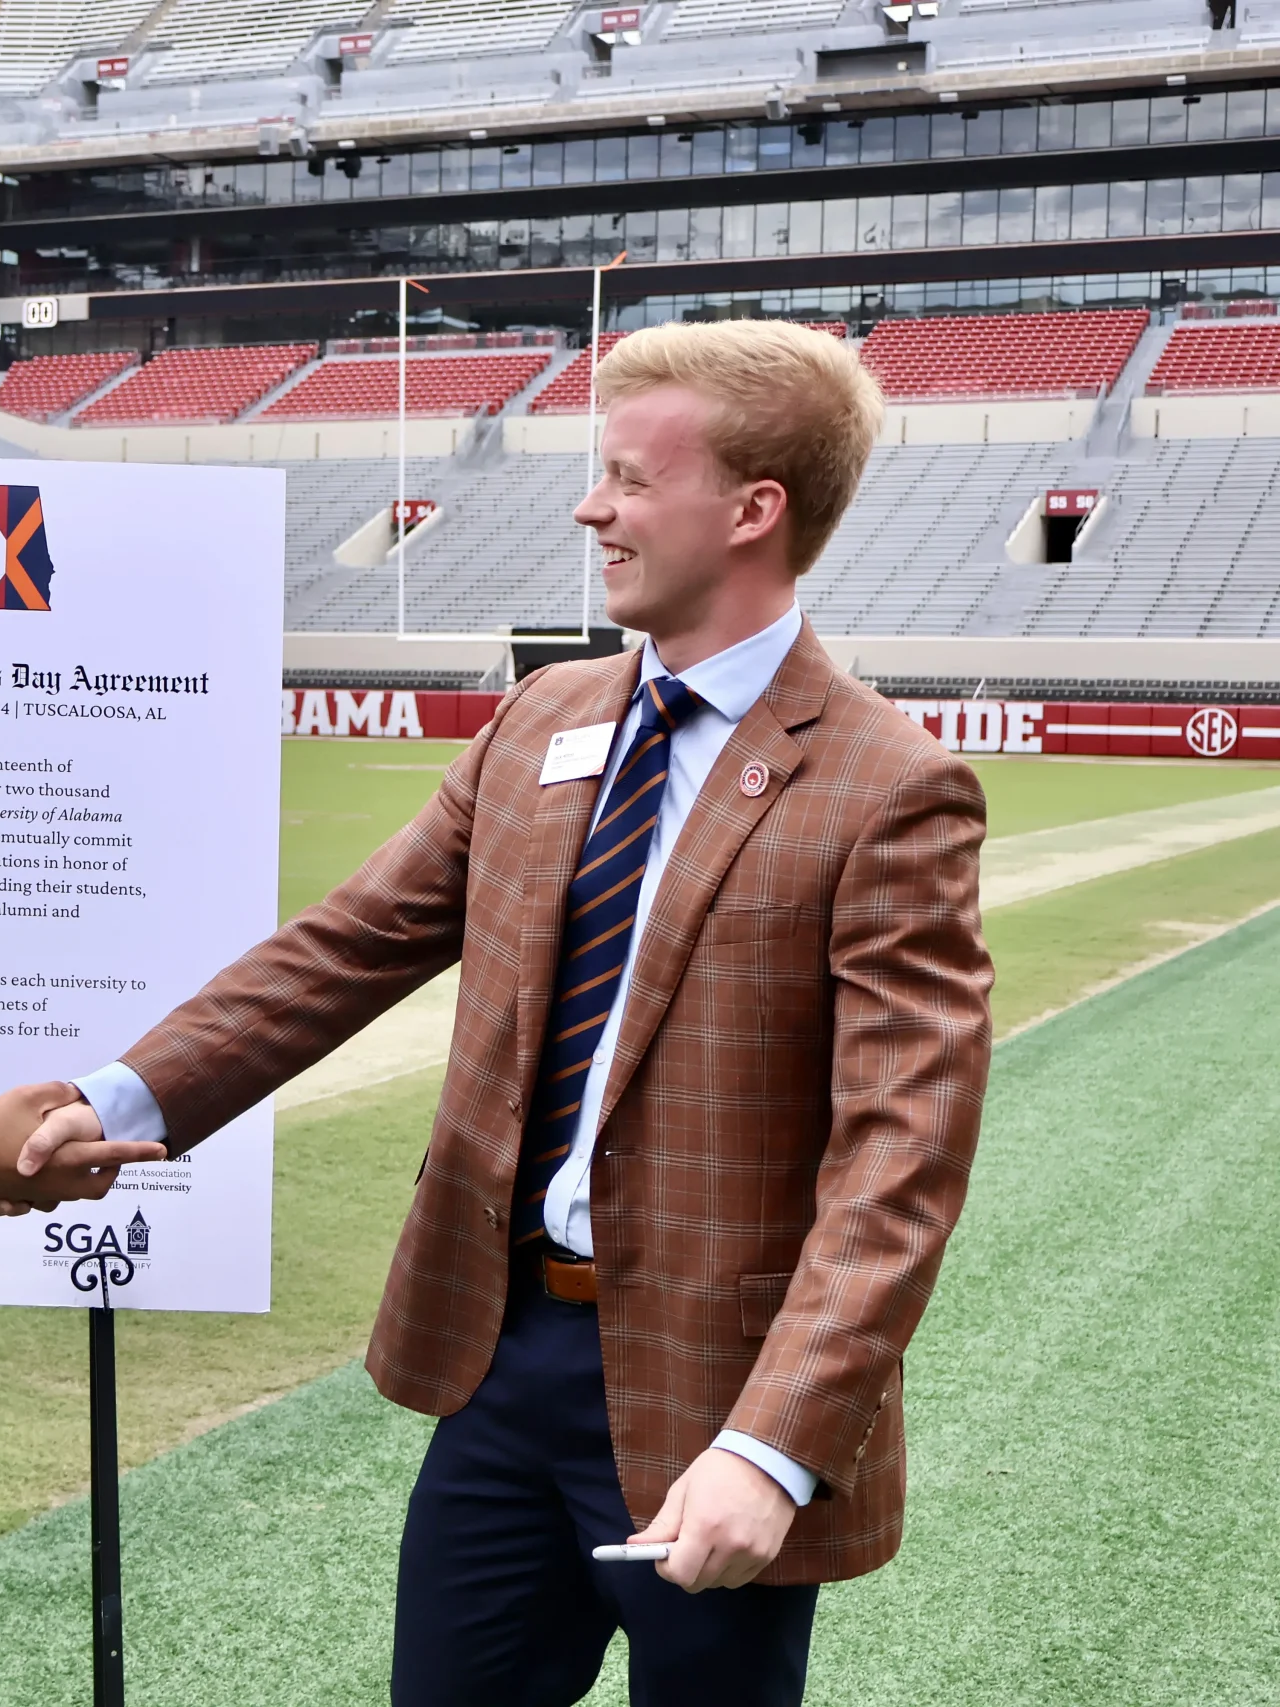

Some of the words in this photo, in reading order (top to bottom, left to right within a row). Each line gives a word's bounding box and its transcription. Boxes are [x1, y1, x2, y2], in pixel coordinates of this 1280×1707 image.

[12, 663, 61, 695] Day
[69, 665, 209, 696] Agreement
[23, 703, 141, 722] TUSCALOOSA,
[145, 707, 166, 720] AL
[1190, 711, 1234, 755] SEC
[57, 759, 73, 772] of
[5, 785, 34, 795] two
[39, 783, 110, 798] thousand
[42, 807, 57, 824] of
[57, 808, 122, 822] Alabama
[1, 831, 70, 849] mutually
[74, 834, 132, 847] commit
[44, 855, 58, 868] in
[63, 856, 108, 870] honor
[113, 857, 128, 871] of
[36, 879, 72, 893] their
[77, 881, 146, 898] students,
[52, 904, 80, 918] and
[11, 973, 46, 987] each
[50, 975, 127, 993] university
[131, 980, 146, 990] to
[32, 998, 48, 1011] of
[18, 1022, 40, 1035] for
[44, 1023, 80, 1037] their
[140, 1168, 192, 1178] Association
[141, 1182, 192, 1194] University
[44, 1222, 122, 1253] SGA
